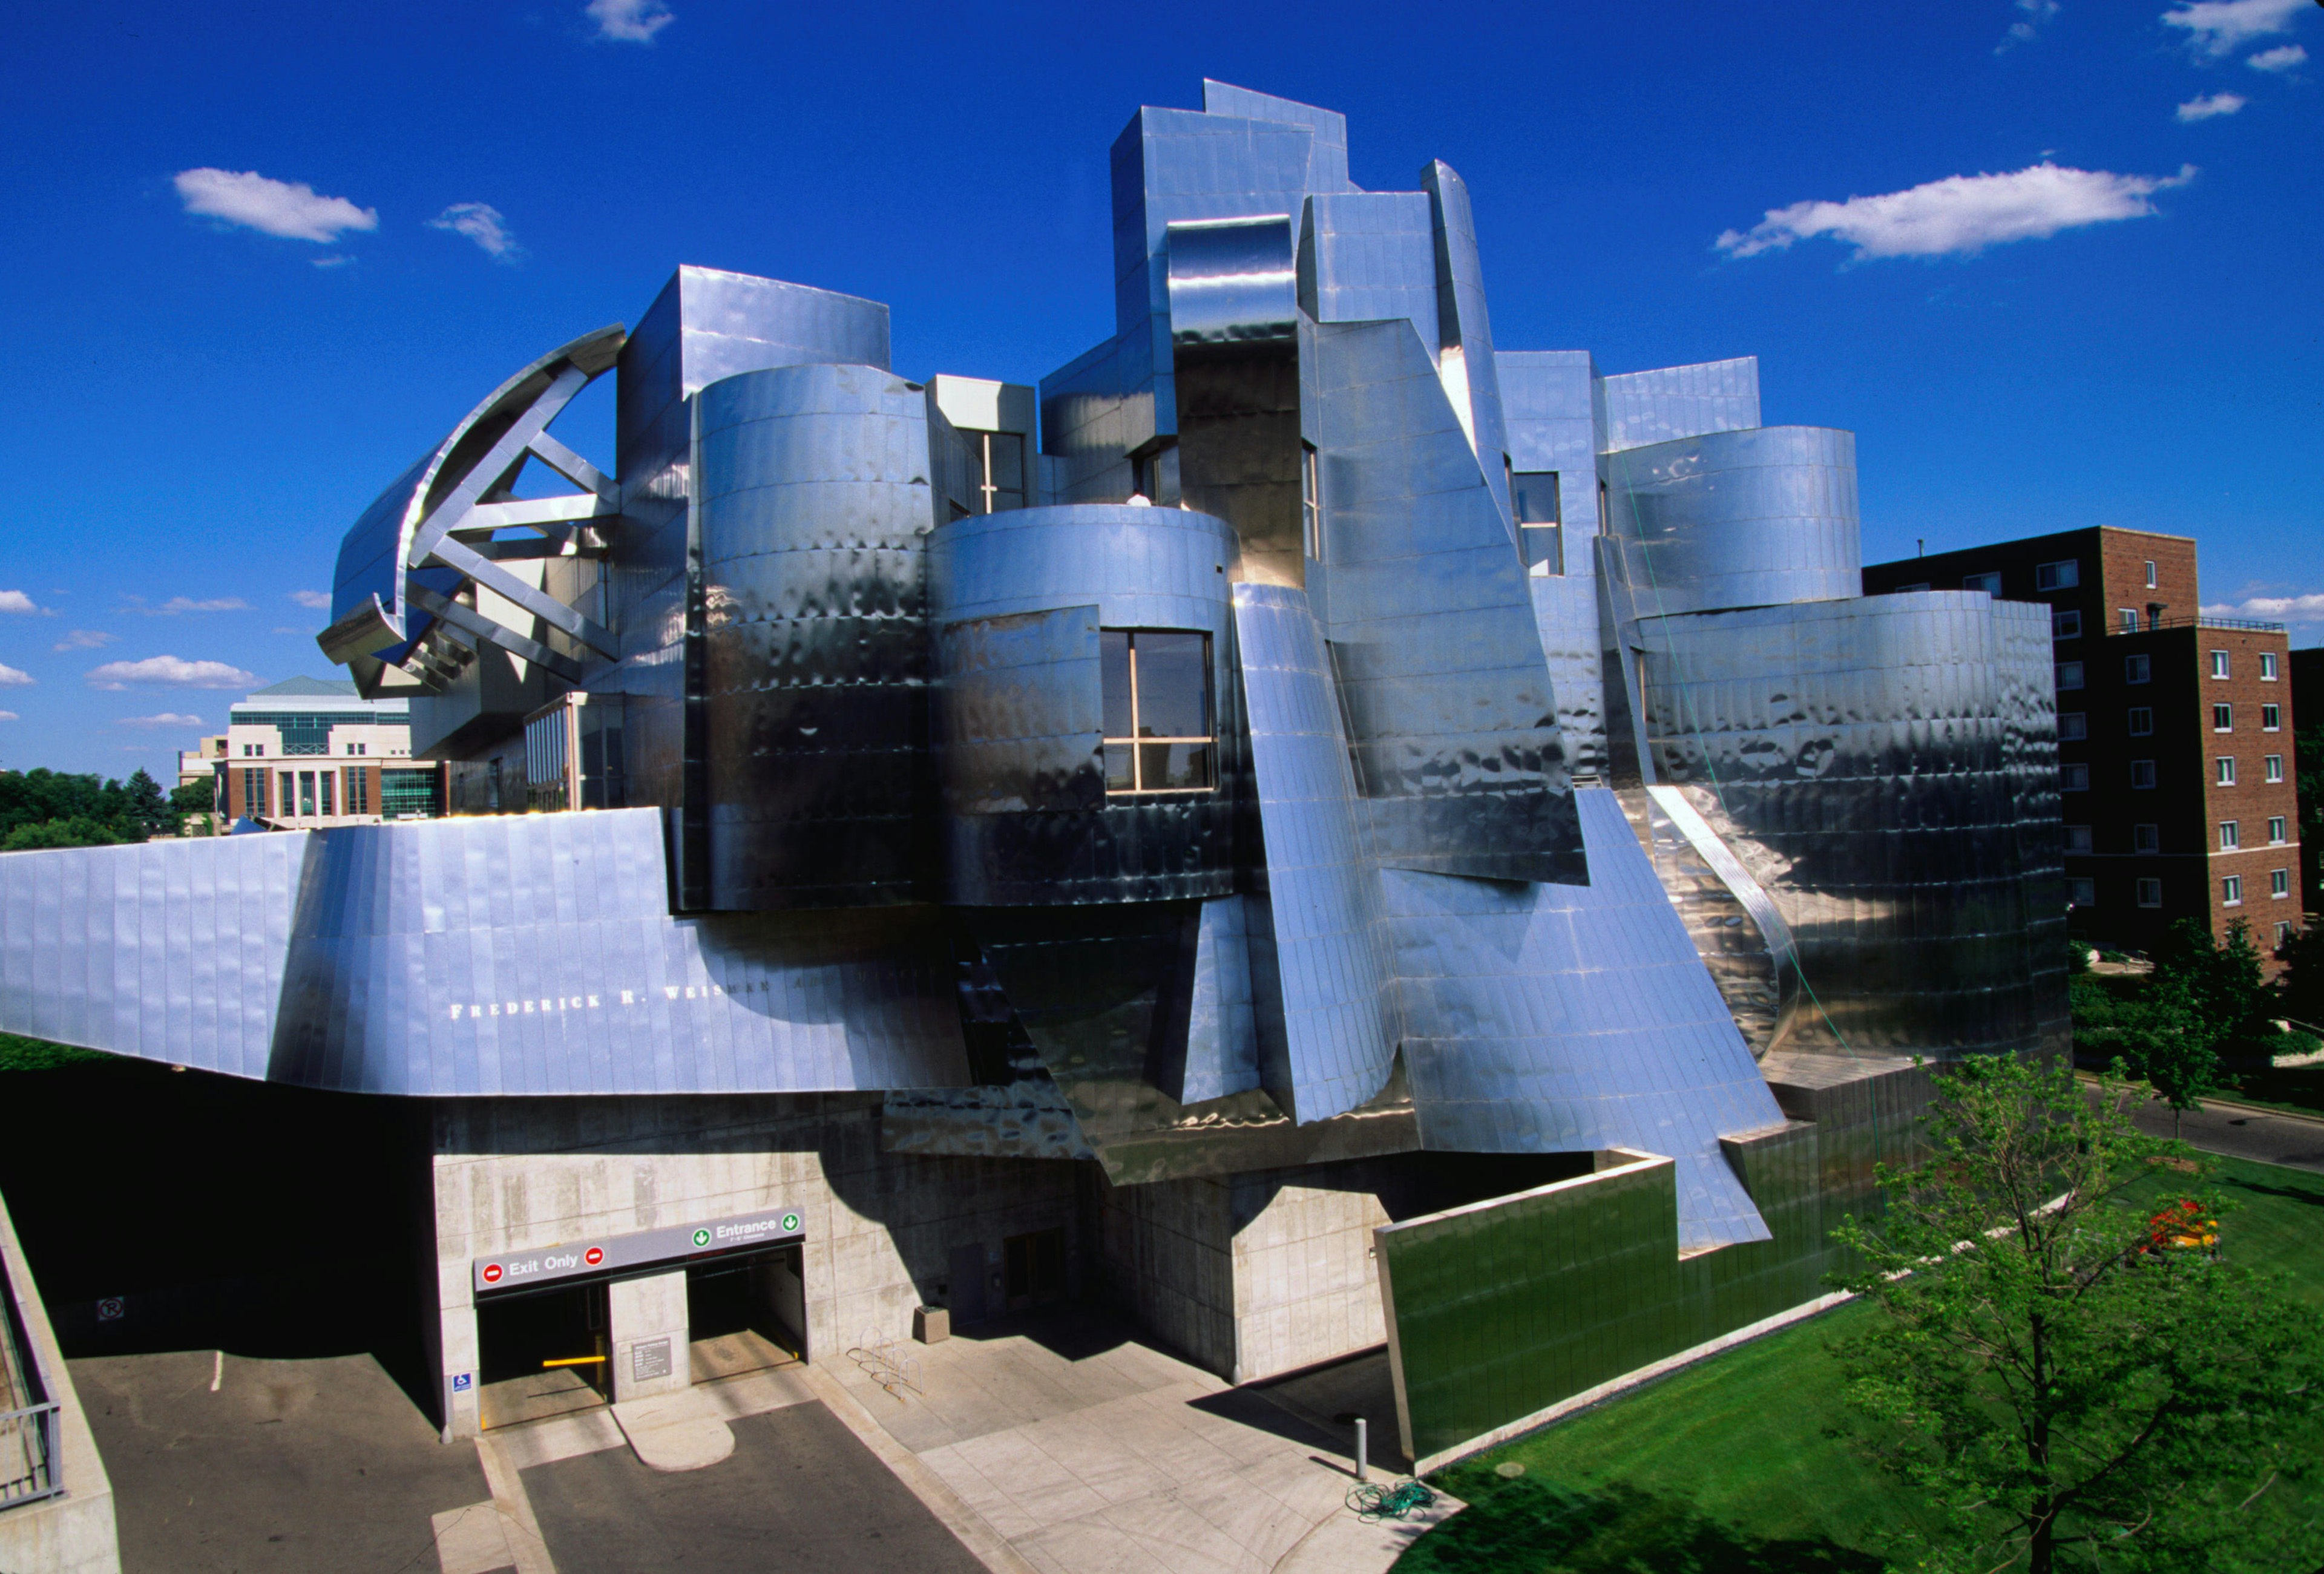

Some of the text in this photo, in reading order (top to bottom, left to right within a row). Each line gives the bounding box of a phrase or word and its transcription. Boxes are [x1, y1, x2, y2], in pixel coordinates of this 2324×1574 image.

[450, 995, 600, 1020] FREDERICK
[620, 989, 647, 1005] R.
[717, 1220, 776, 1239] Entrance
[509, 1253, 579, 1276] Exit Only
